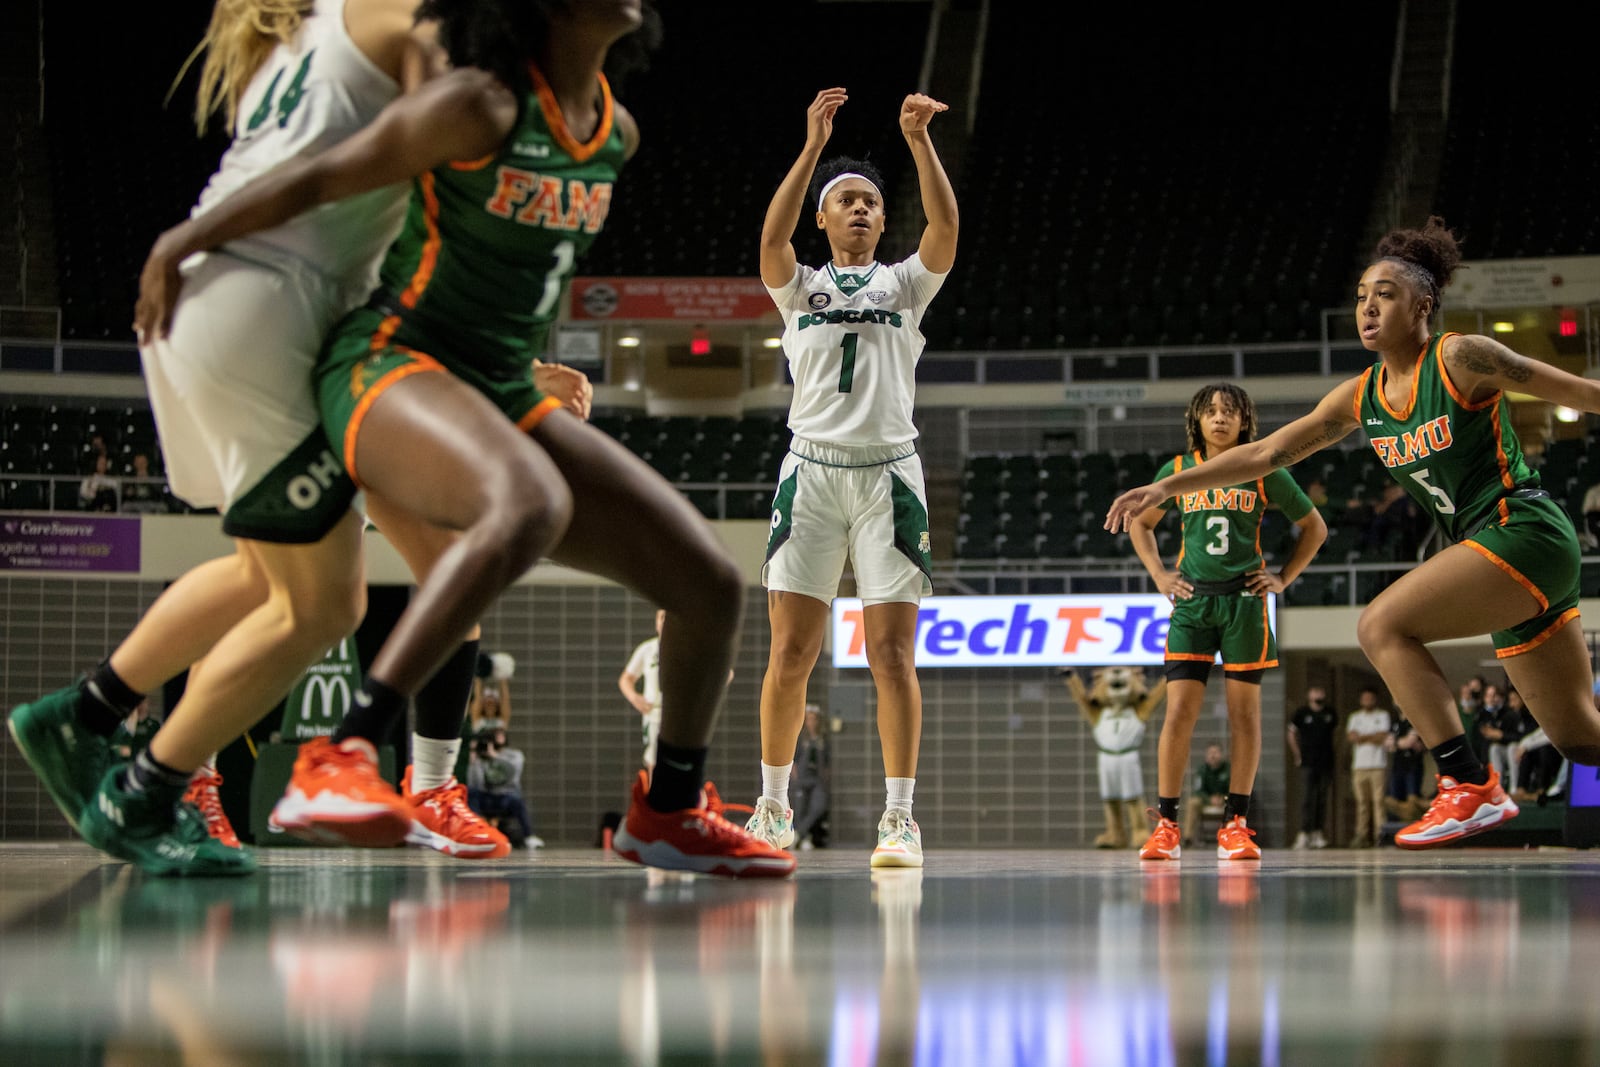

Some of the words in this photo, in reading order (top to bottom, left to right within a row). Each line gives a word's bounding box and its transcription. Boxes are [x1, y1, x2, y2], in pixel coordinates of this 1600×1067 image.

[485, 165, 613, 234] FAM
[533, 241, 575, 318] 1
[798, 309, 902, 331] BOBCATS
[838, 333, 858, 393] 1
[1370, 414, 1453, 468] FAMU
[1182, 488, 1258, 514] FAMU
[1409, 468, 1456, 514] 5
[20, 520, 94, 536] CareSource
[1206, 516, 1229, 555] 3
